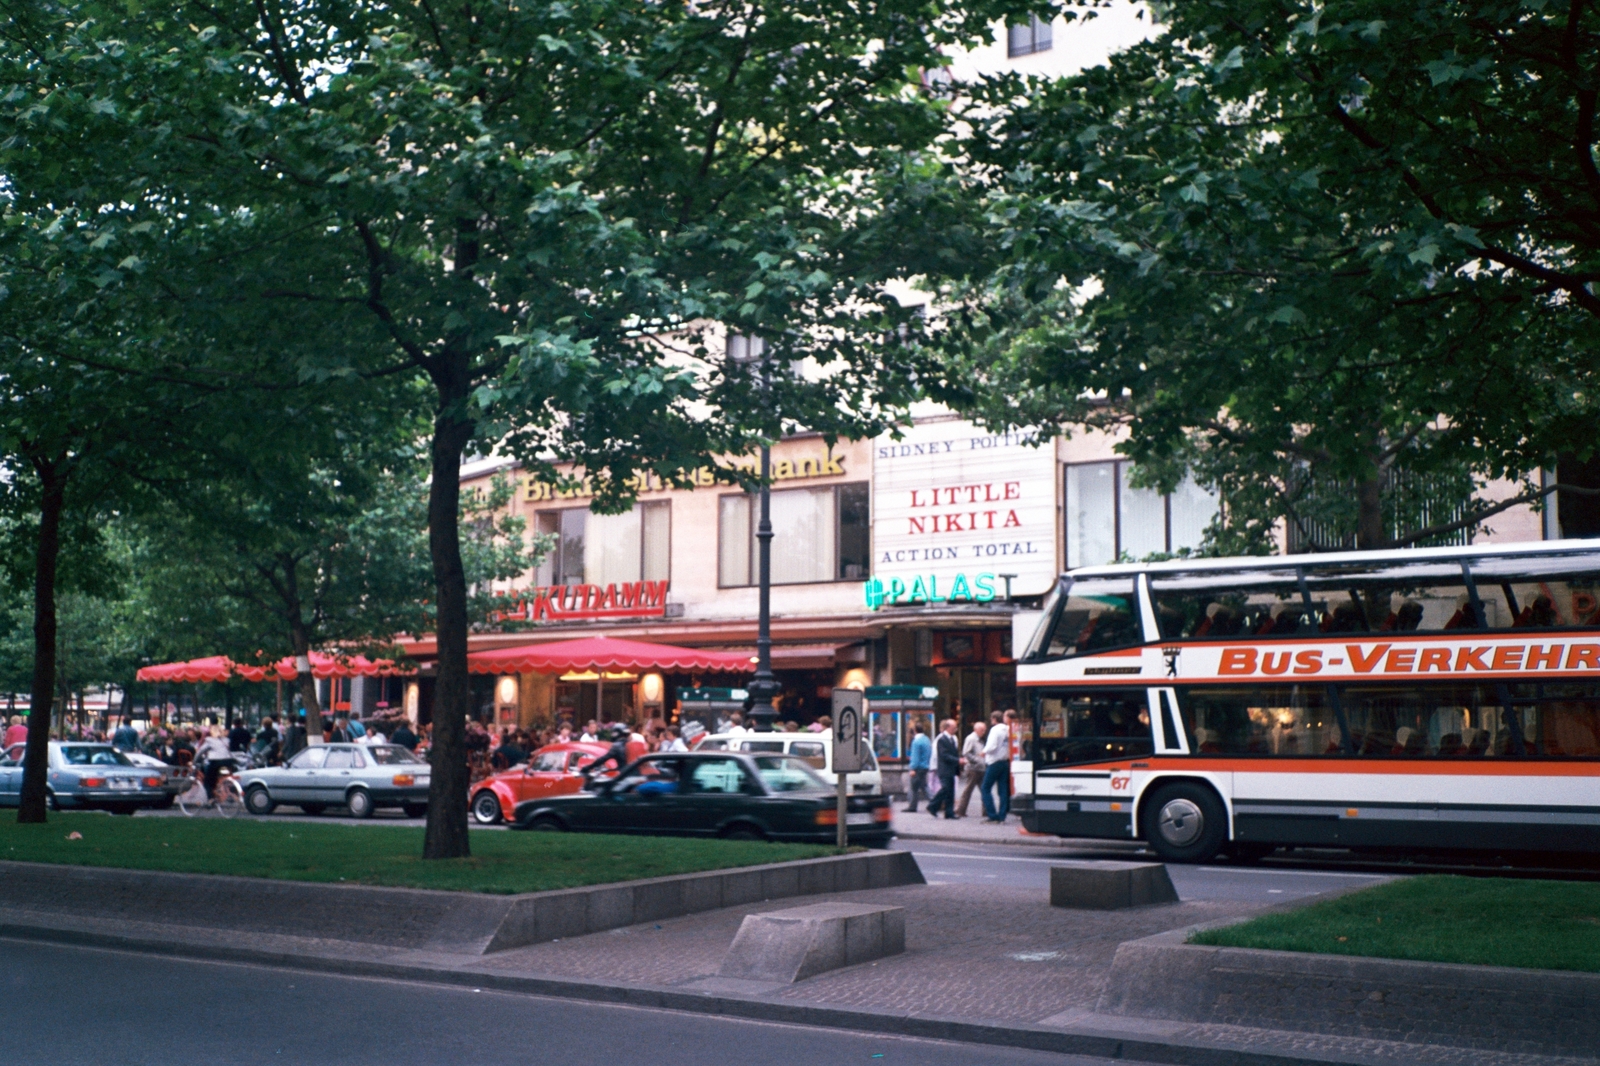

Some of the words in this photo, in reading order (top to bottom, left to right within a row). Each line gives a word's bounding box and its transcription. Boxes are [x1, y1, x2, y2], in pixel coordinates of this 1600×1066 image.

[879, 440, 954, 458] SIDNEY
[910, 481, 1020, 507] LITTLE
[908, 509, 1022, 534] NIKITA
[881, 547, 958, 563] ACTION
[973, 541, 1038, 557] TOTAL
[888, 571, 1018, 605] PALAST
[1111, 777, 1130, 790] 67
